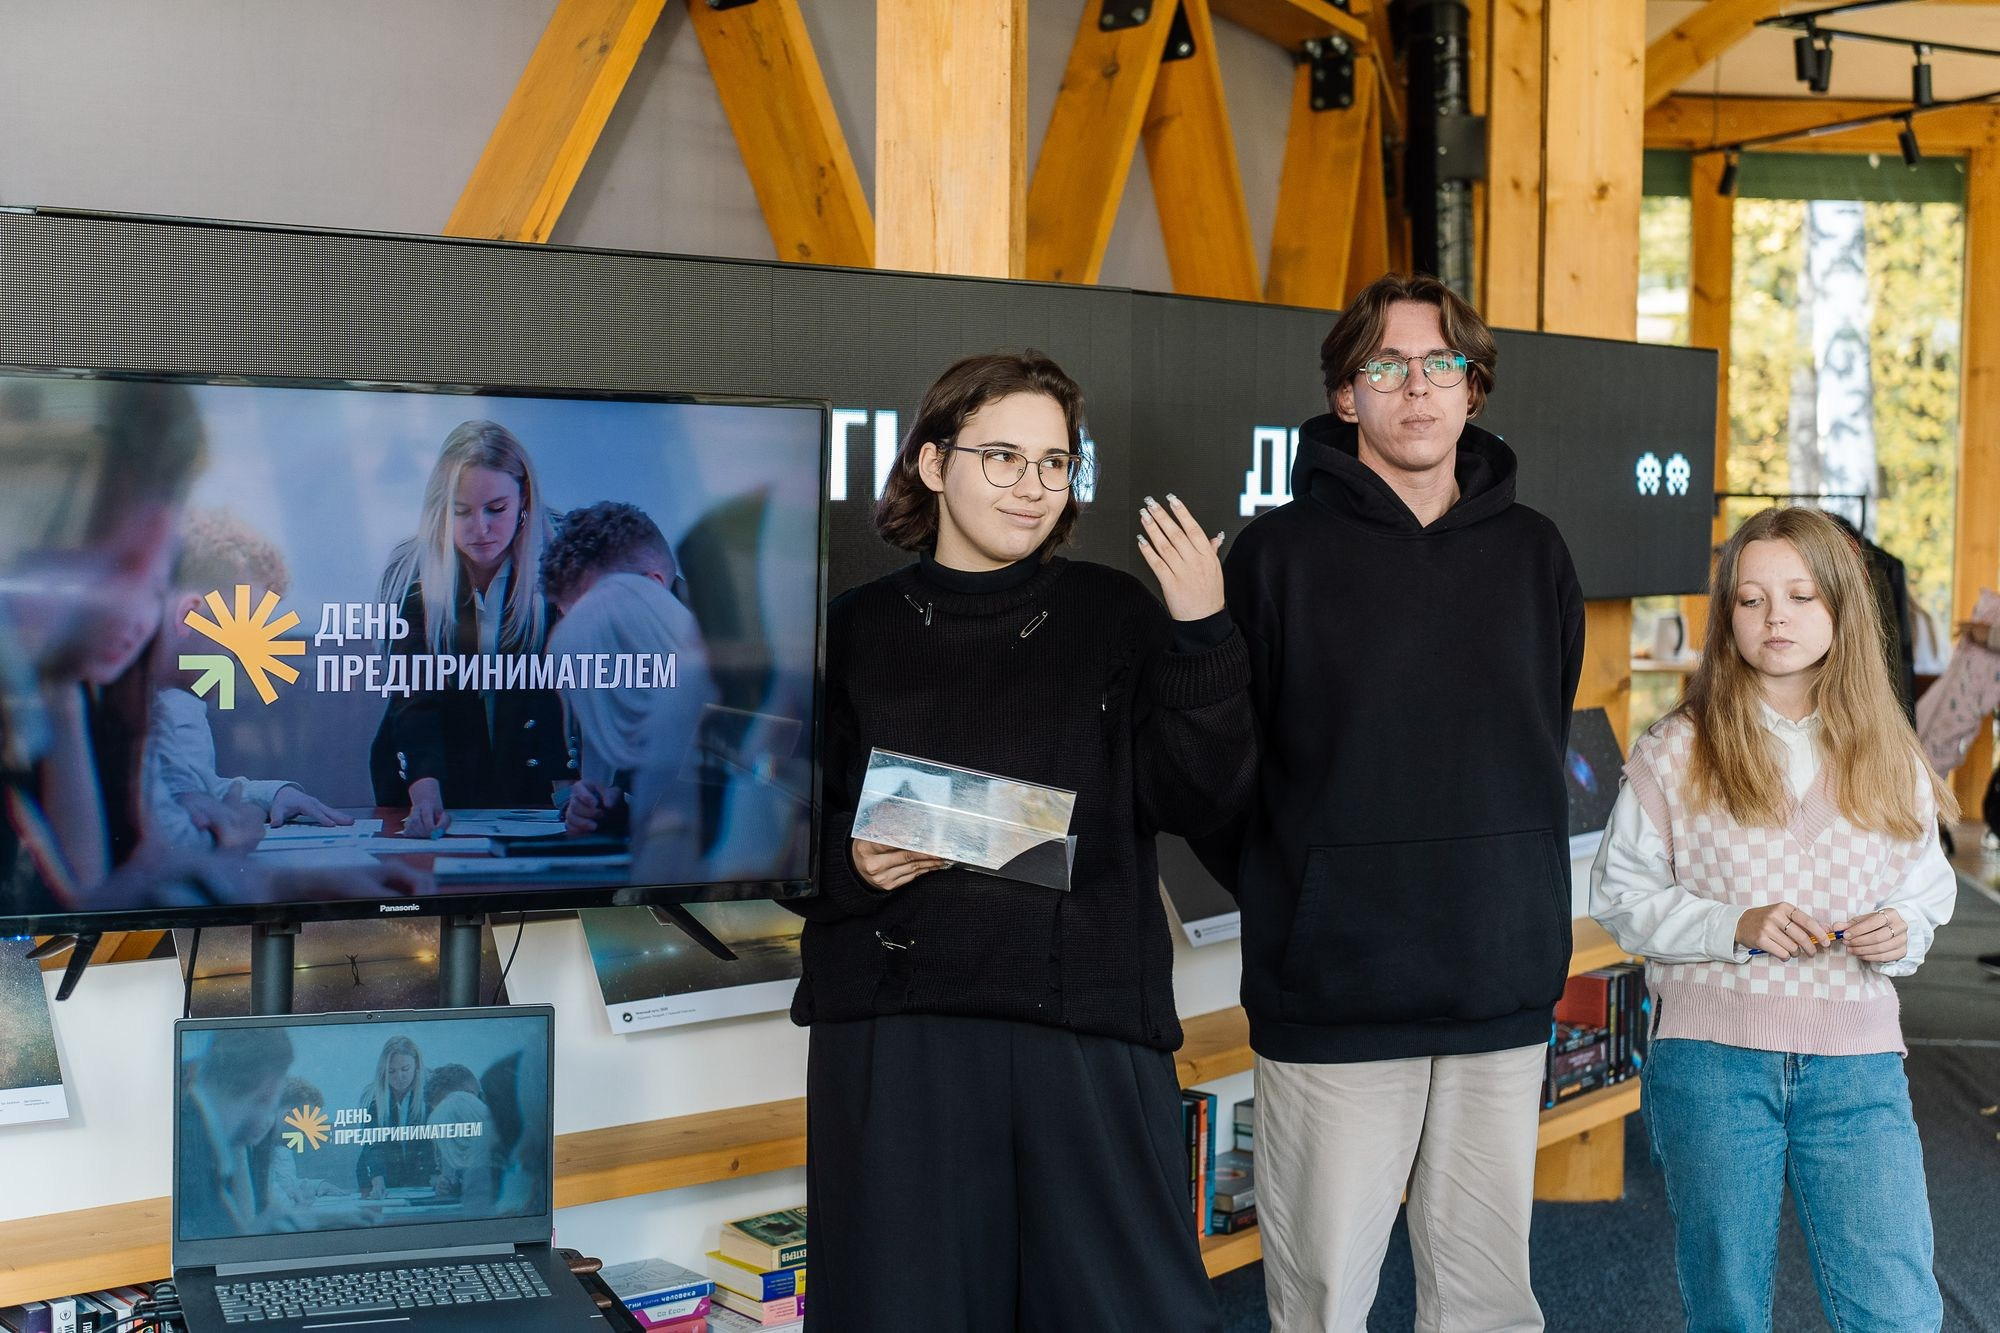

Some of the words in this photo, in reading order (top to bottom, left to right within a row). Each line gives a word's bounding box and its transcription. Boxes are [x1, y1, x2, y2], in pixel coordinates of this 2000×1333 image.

[314, 602, 410, 647] ДЕНЬ
[316, 653, 677, 698] ПРЕДПРИНИМАТЕЛЕМ
[379, 903, 420, 912] Panasonic
[334, 1108, 372, 1127] ДЕНЬ
[334, 1122, 483, 1146] ПРЕДПРИНИМАТЕЛЕМ
[661, 1290, 696, 1302] человека
